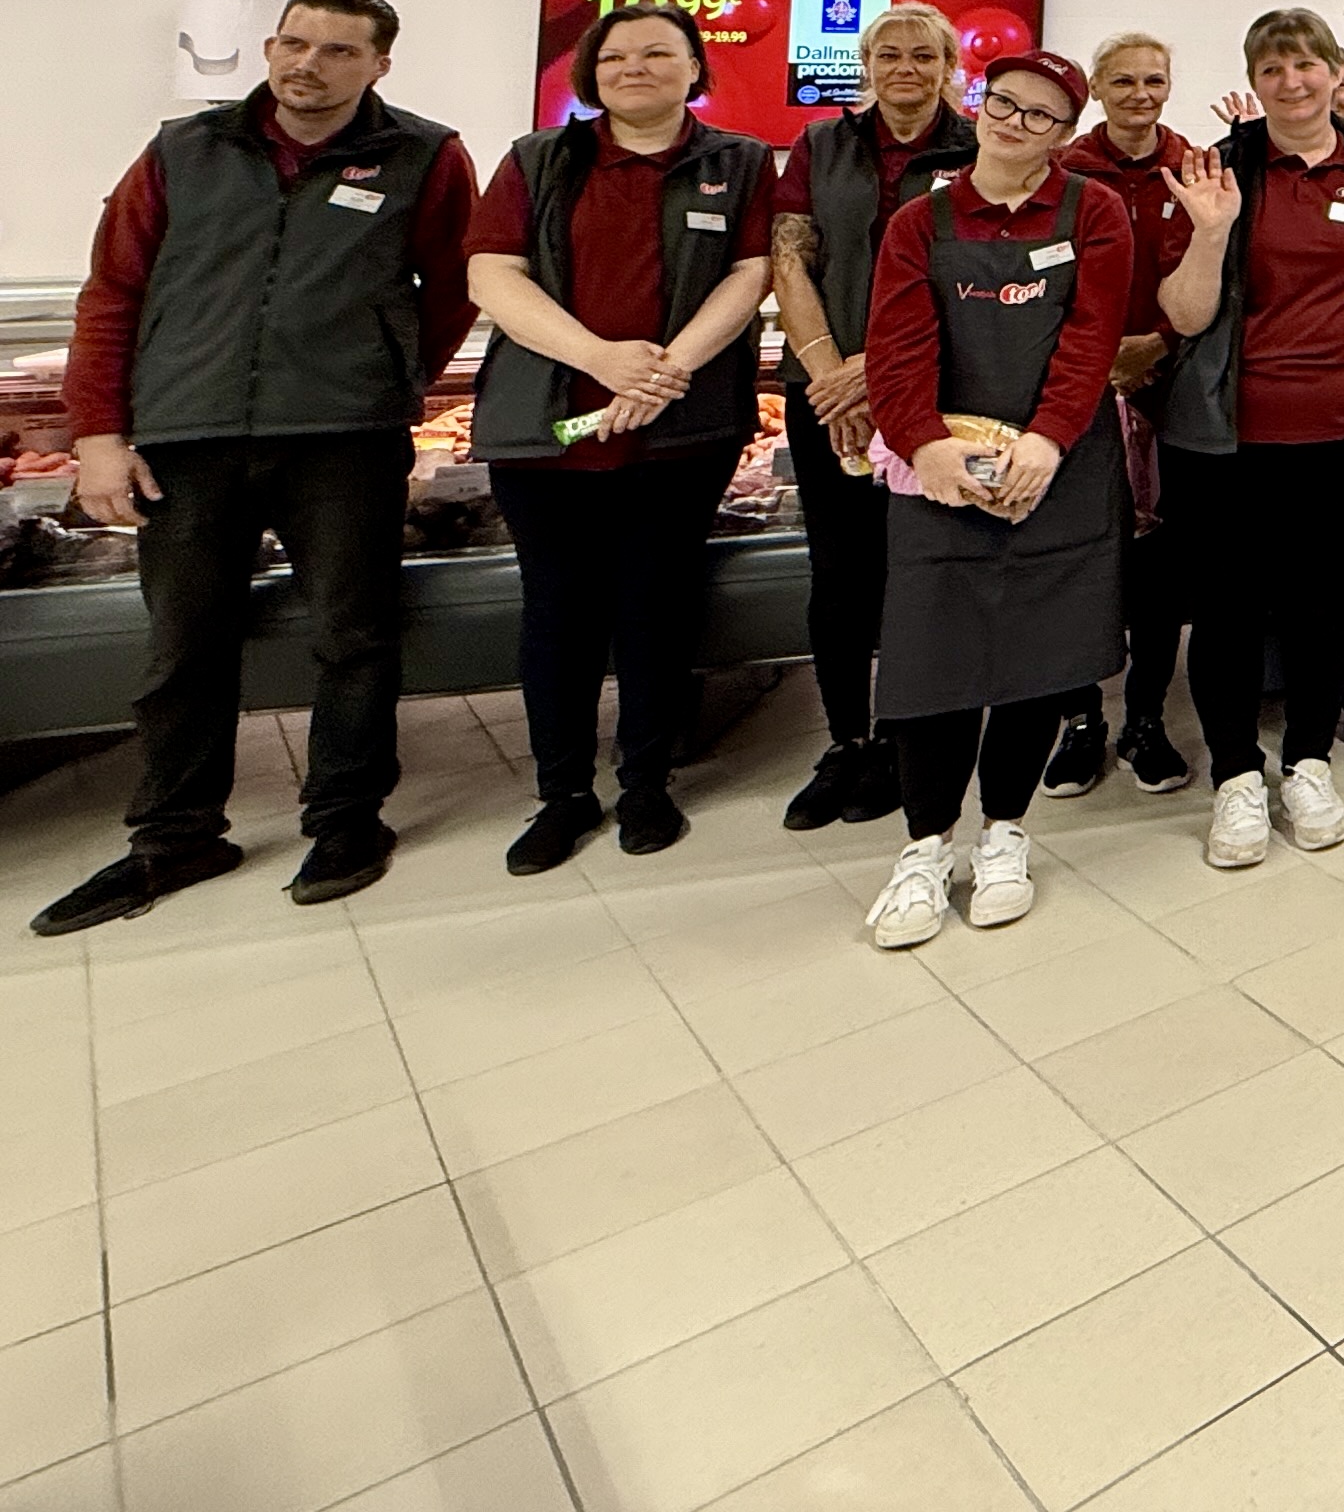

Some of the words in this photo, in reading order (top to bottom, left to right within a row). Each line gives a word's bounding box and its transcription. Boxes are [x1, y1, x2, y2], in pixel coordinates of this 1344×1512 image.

[796, 45, 862, 60] Dallma
[797, 62, 866, 79] prodom
[1000, 278, 1046, 304] top!
